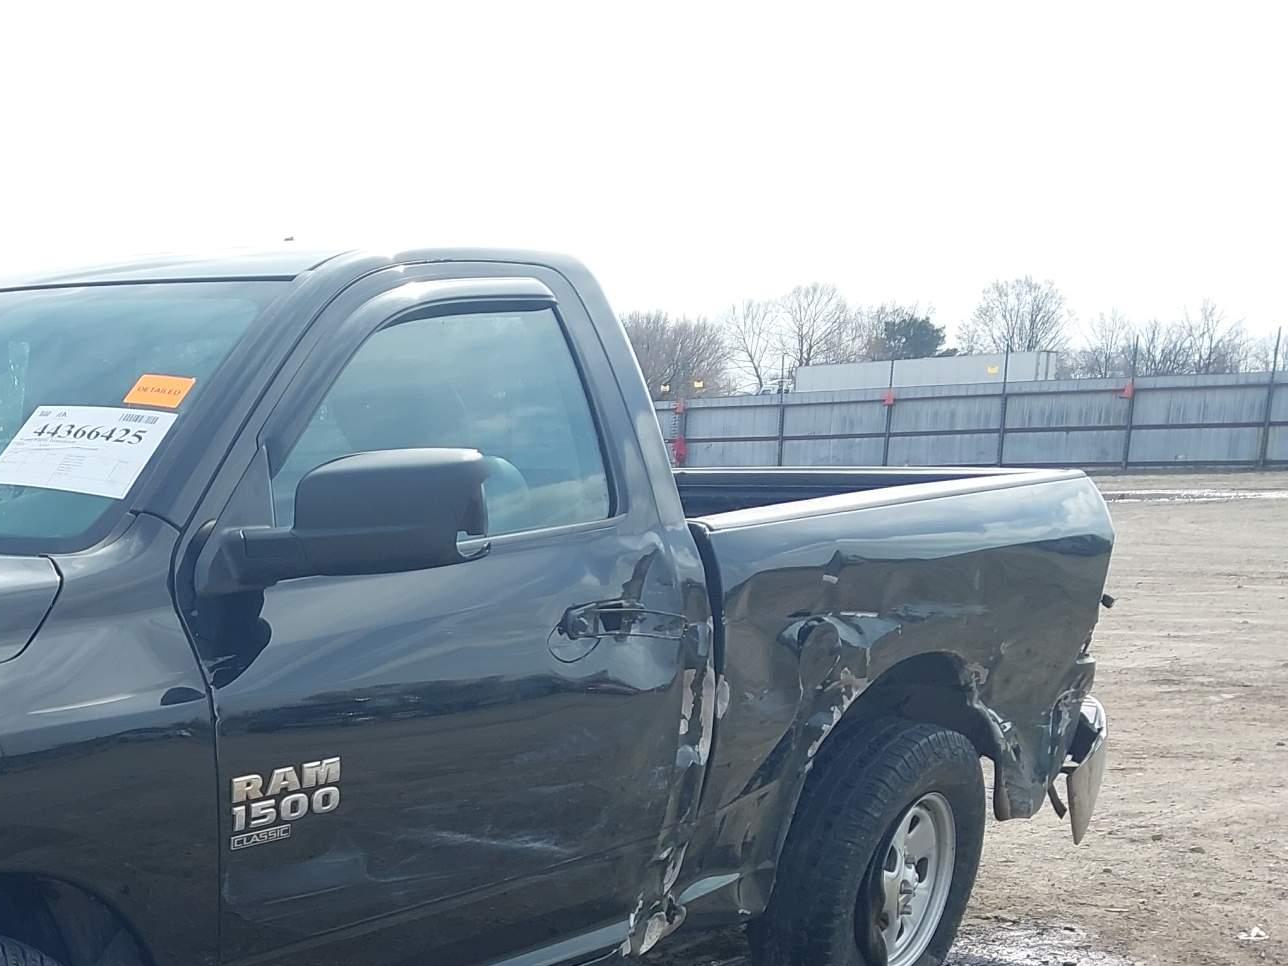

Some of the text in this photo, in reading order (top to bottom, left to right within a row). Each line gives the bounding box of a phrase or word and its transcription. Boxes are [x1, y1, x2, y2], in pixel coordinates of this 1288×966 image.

[33, 423, 148, 445] 44366425
[231, 756, 341, 804] RAM
[232, 786, 341, 832] 1500
[232, 825, 291, 849] CLASSIC
